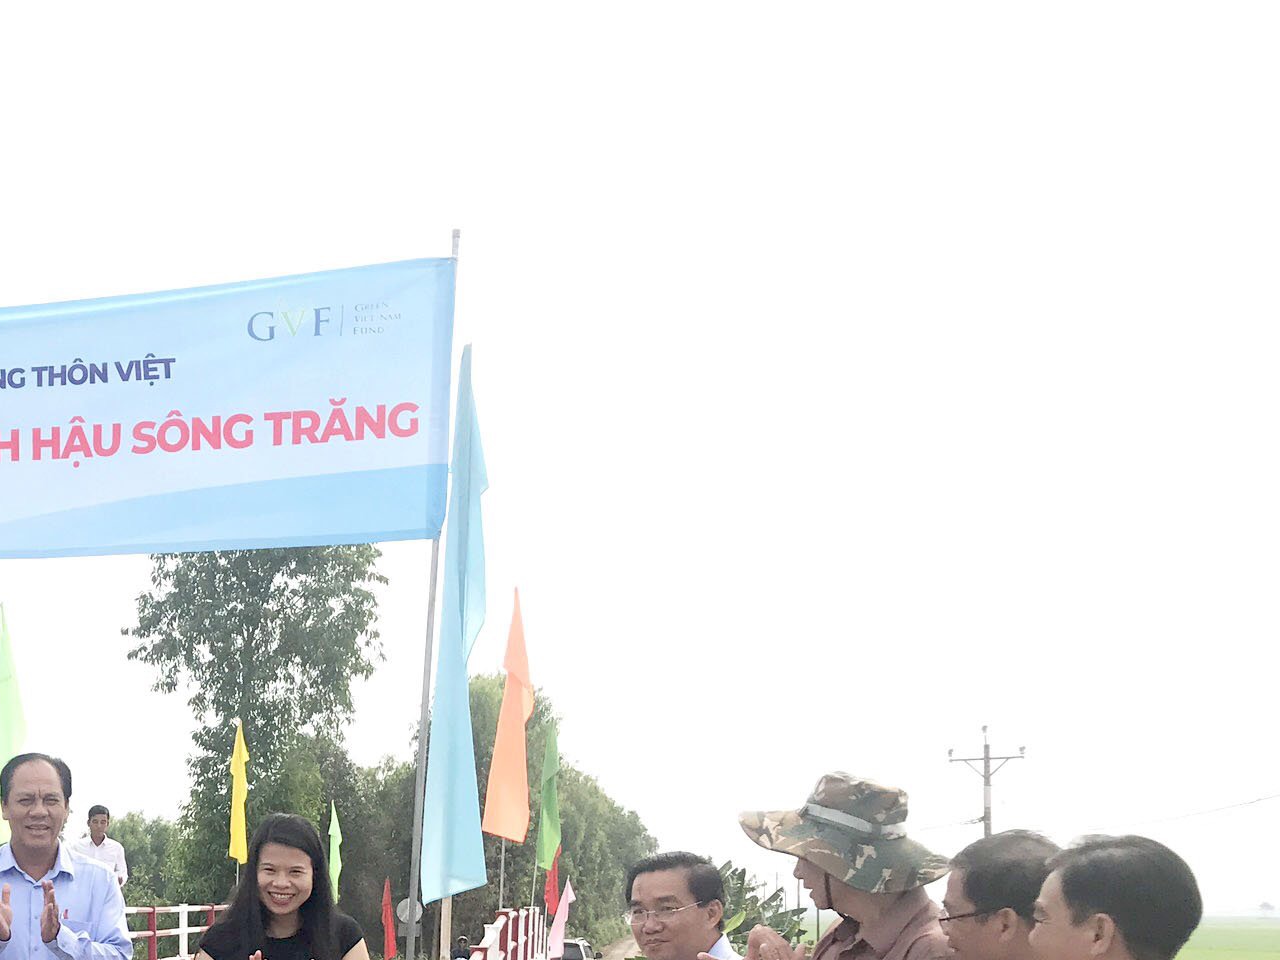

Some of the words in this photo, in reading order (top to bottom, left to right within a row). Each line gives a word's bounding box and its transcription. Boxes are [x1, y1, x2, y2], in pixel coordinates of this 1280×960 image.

[247, 306, 331, 342] GVF
[31, 357, 109, 387] THÔN
[115, 353, 176, 386] VIỆT
[32, 416, 121, 468] HẬU
[131, 409, 254, 455] SÔNG
[264, 397, 420, 446] TRĂNG
